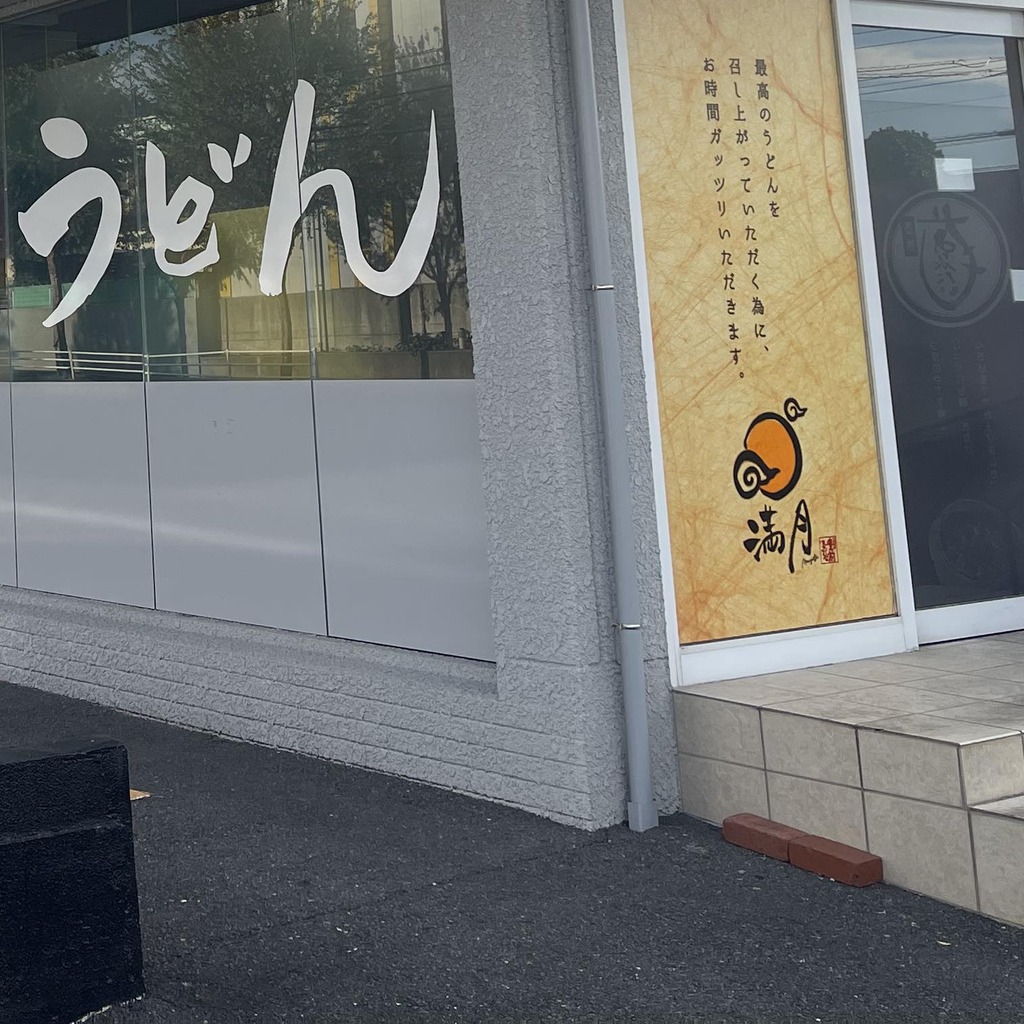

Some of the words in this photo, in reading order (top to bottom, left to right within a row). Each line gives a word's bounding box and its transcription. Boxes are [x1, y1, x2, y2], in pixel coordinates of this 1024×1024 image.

[17, 78, 440, 328] うどん
[703, 57, 745, 378] お時間ガッツリいただきます。
[729, 58, 769, 351] 召し上がっていただく為に、
[755, 58, 780, 218] 最高のうどんを
[743, 499, 812, 574] 満月
